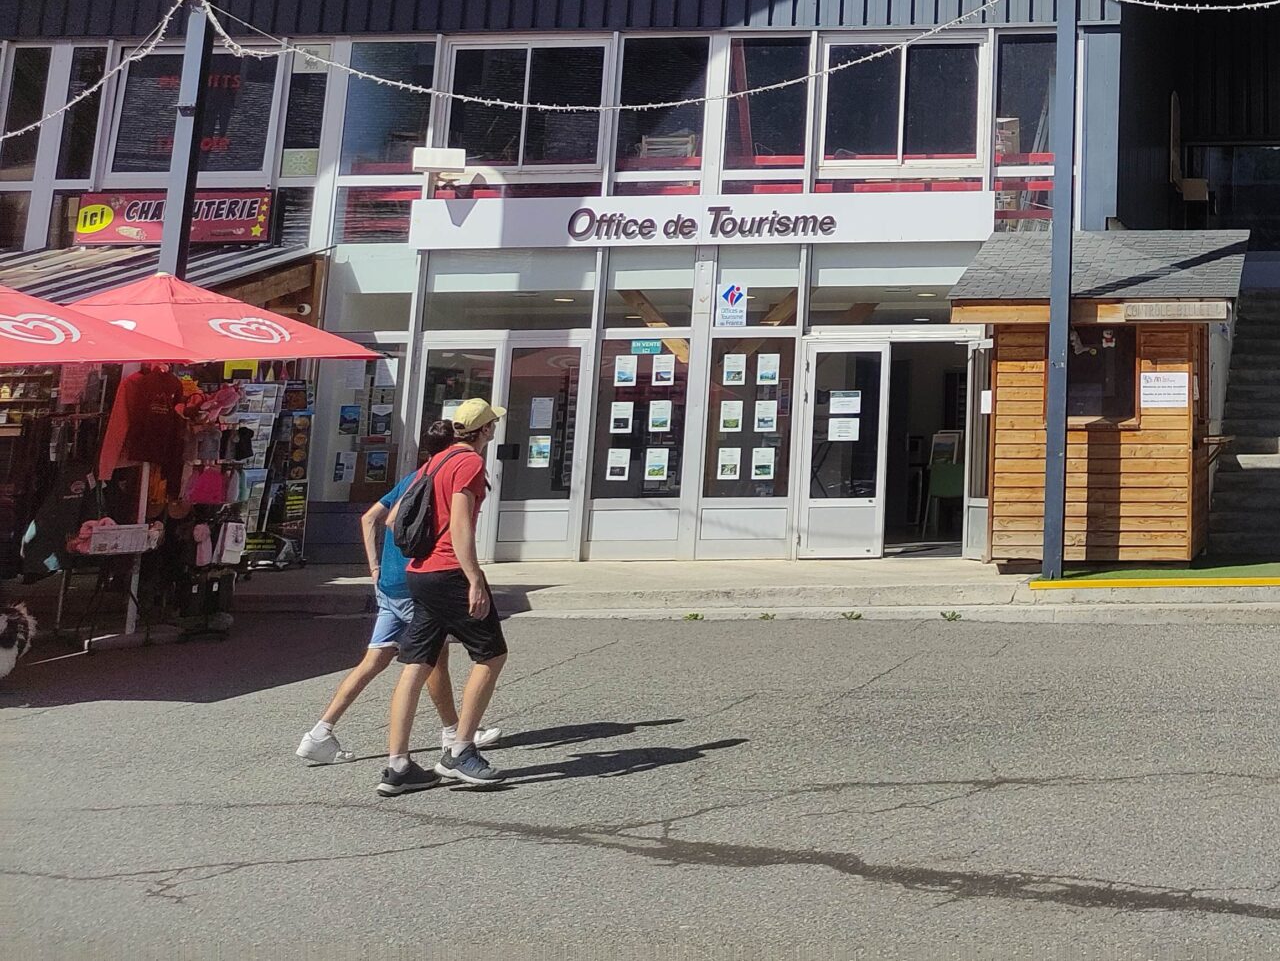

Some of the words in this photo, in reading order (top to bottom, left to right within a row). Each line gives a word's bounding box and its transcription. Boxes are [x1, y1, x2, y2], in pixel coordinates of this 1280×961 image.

[82, 209, 106, 229] ici
[567, 207, 657, 241] Office
[663, 213, 699, 239] de
[707, 206, 837, 238] Tourisme
